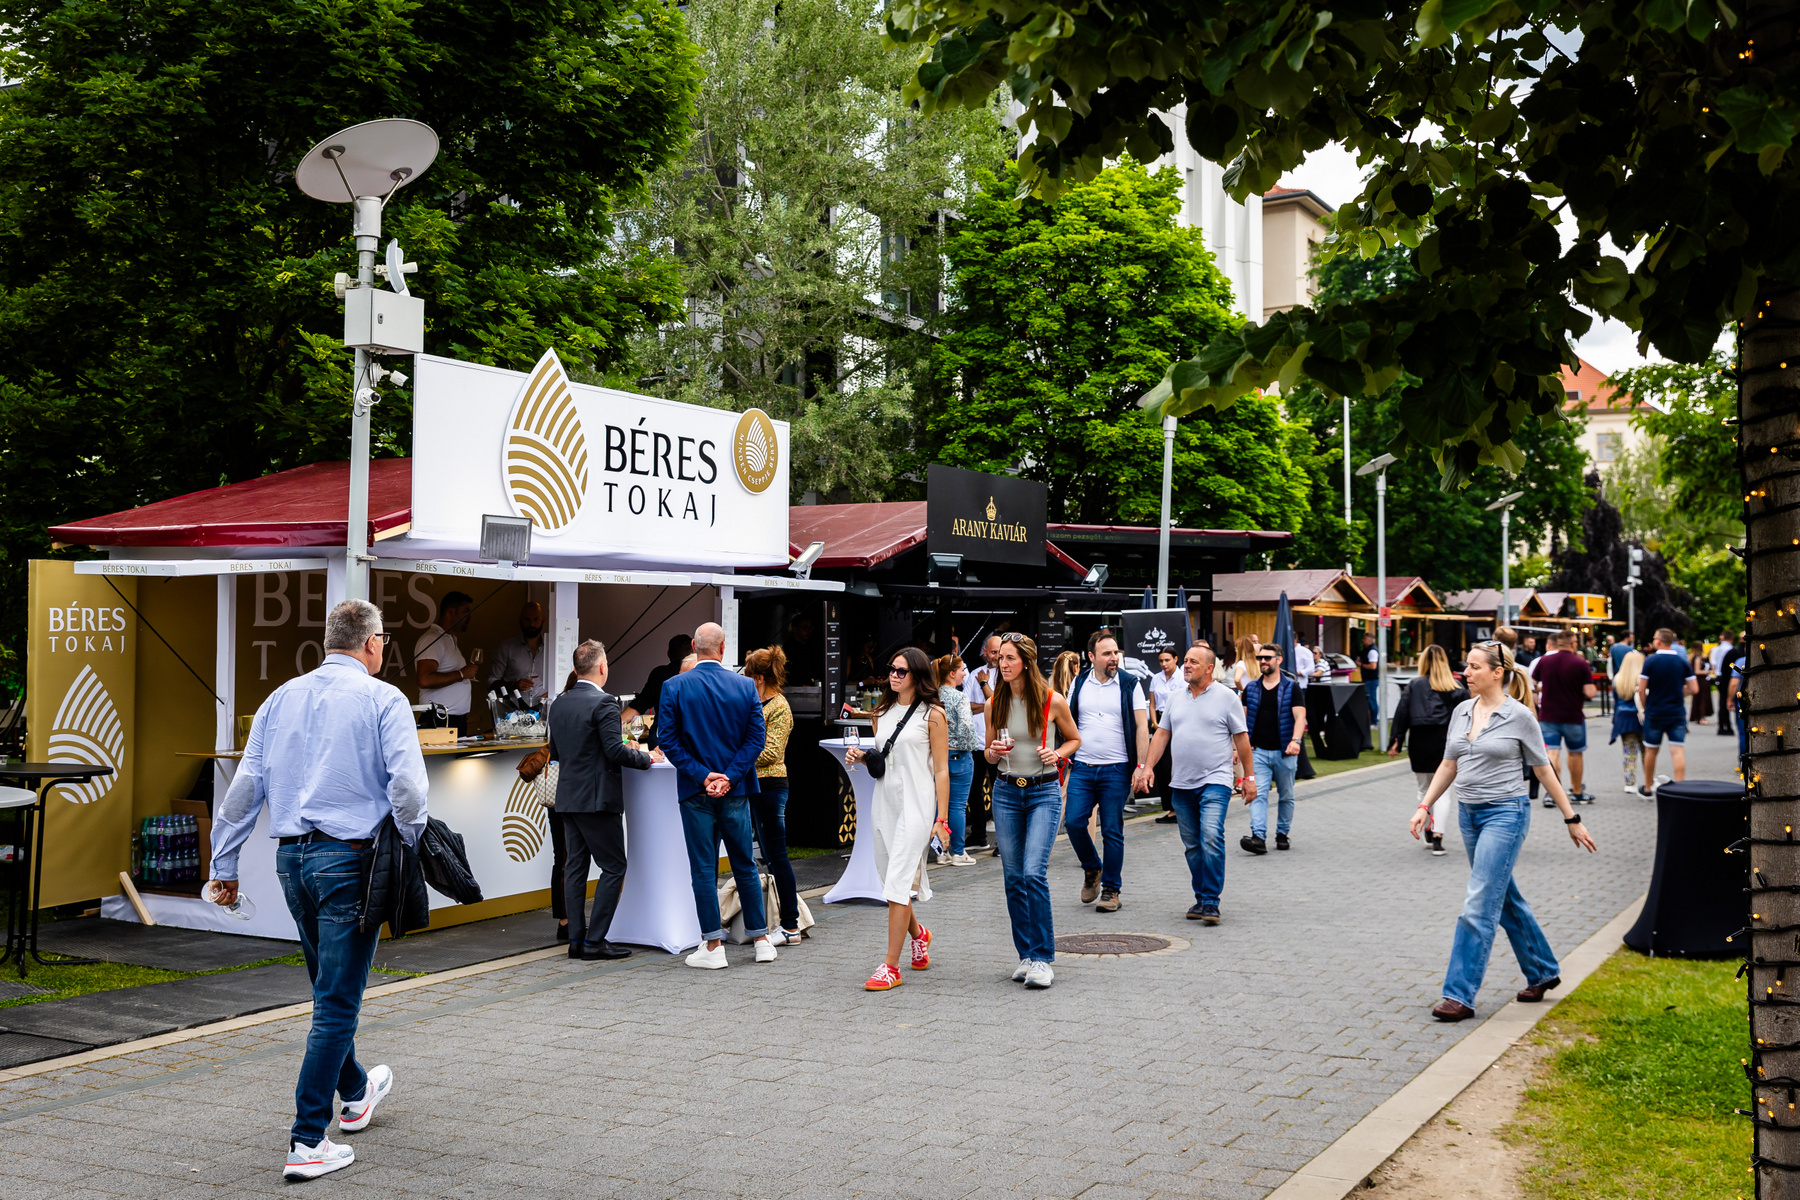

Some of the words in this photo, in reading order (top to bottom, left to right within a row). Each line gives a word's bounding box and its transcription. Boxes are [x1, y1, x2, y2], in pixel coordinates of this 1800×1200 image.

[603, 416, 718, 485] BÉRES
[603, 482, 716, 528] TOKAJ
[951, 517, 989, 539] ARANY
[990, 521, 1028, 543] KAVIÁR
[102, 563, 124, 573] BÉRES
[127, 565, 148, 574] TOKAJ
[230, 562, 254, 572] BÉRES
[269, 561, 292, 570] TOKAJ
[415, 562, 438, 572] BÉRES
[452, 566, 475, 577] TOKAJ
[584, 573, 602, 582] BÉRES
[613, 575, 632, 583] TOKAJ
[48, 600, 127, 632] BÉRES
[48, 635, 125, 654] TOKAJ
